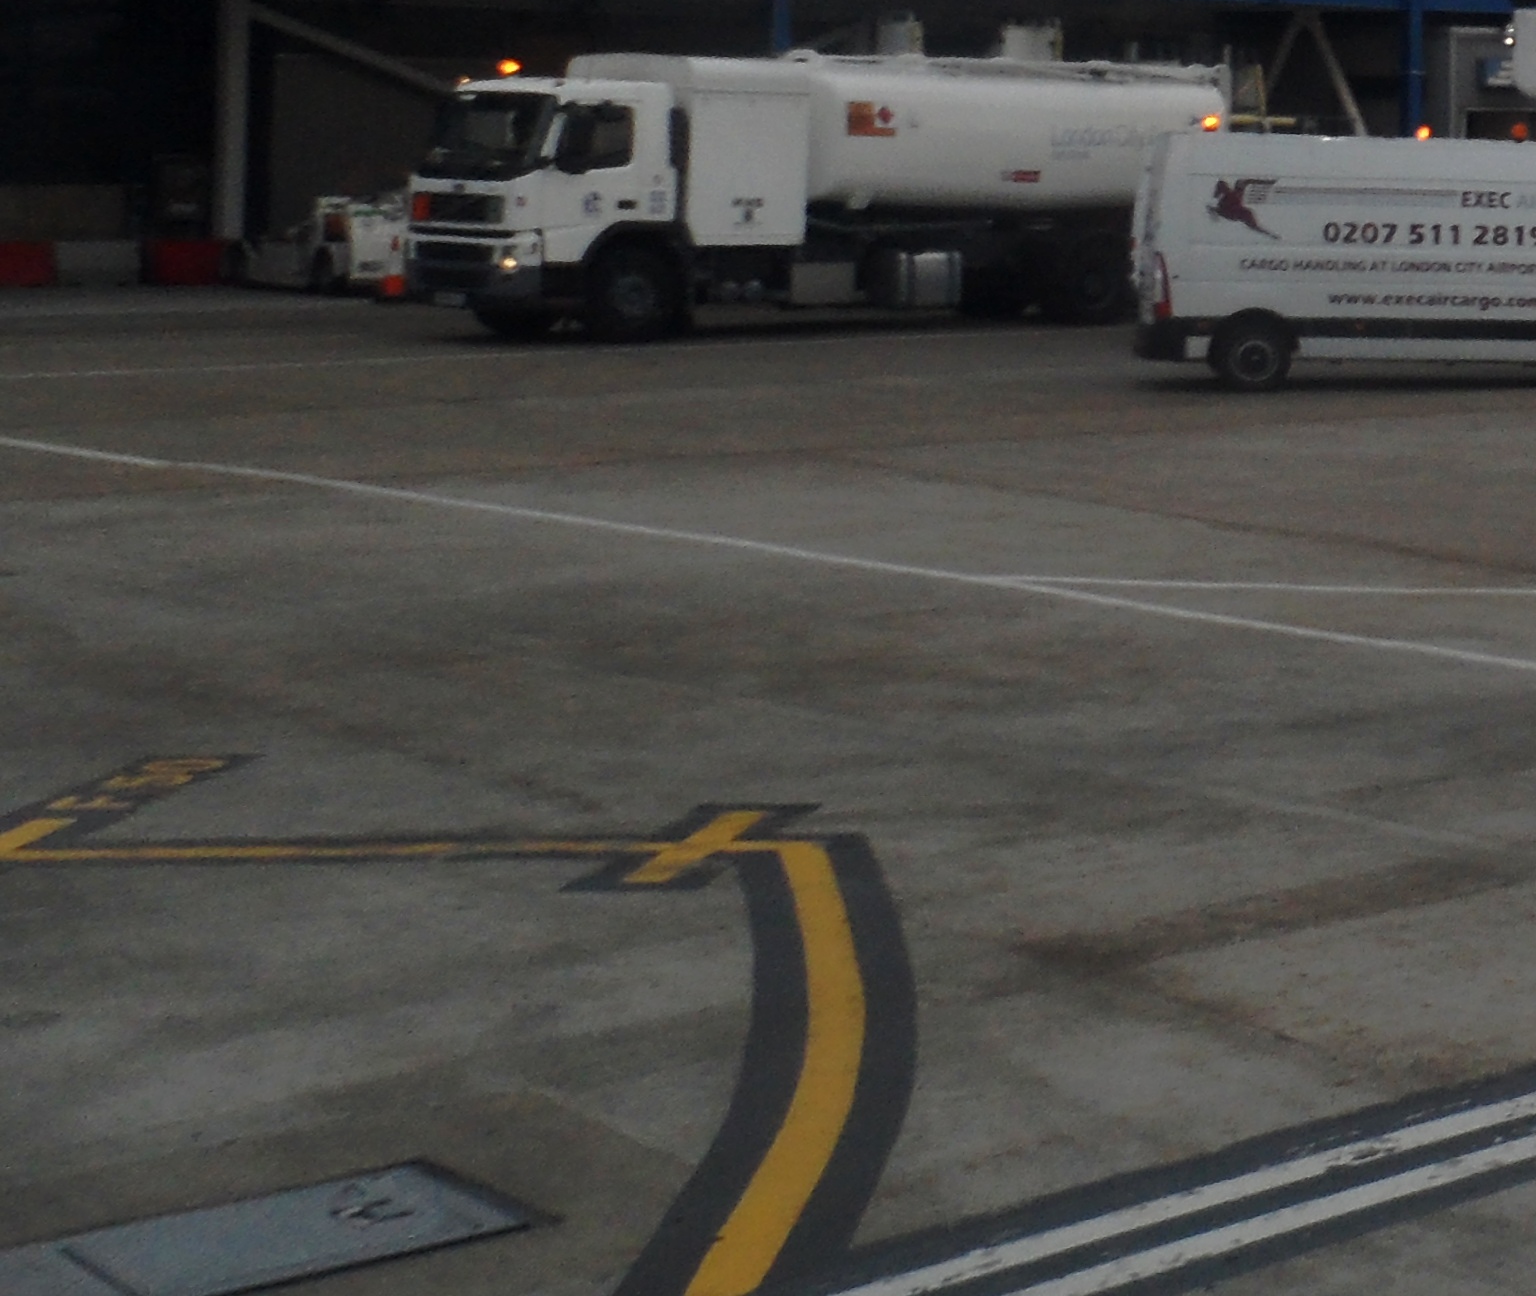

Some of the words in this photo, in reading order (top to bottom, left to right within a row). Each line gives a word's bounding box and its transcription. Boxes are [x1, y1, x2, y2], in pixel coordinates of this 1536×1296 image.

[1461, 191, 1512, 209] EXEC
[1323, 221, 1398, 244] 0207
[1408, 223, 1461, 245] 511
[1240, 259, 1289, 272] CARGO
[1293, 260, 1366, 272] HANDLING
[1368, 260, 1387, 272] AT
[1391, 260, 1452, 273] LONDON
[1455, 261, 1482, 273] CITY
